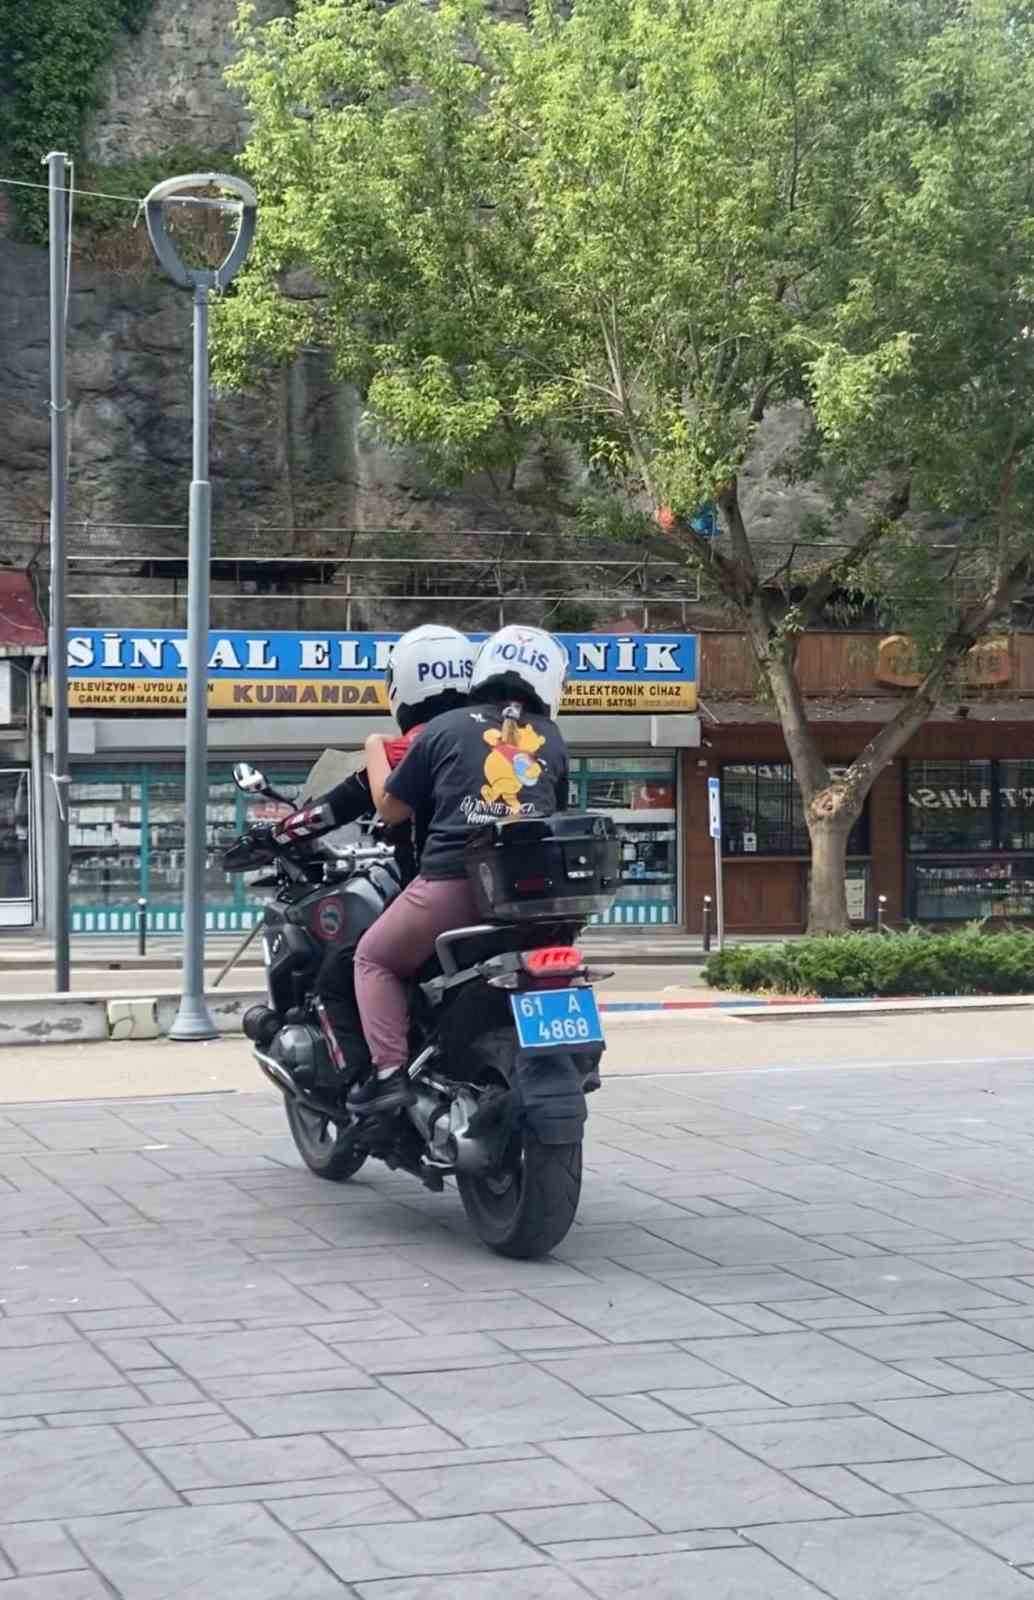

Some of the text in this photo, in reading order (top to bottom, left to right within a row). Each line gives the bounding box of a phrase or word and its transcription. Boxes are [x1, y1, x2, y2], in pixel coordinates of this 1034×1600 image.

[143, 682, 173, 692] UYDU
[233, 684, 380, 704] KUMANDA
[649, 684, 681, 697] CİHAZ
[520, 993, 581, 1017] 61 A
[538, 1017, 590, 1041] 4868
